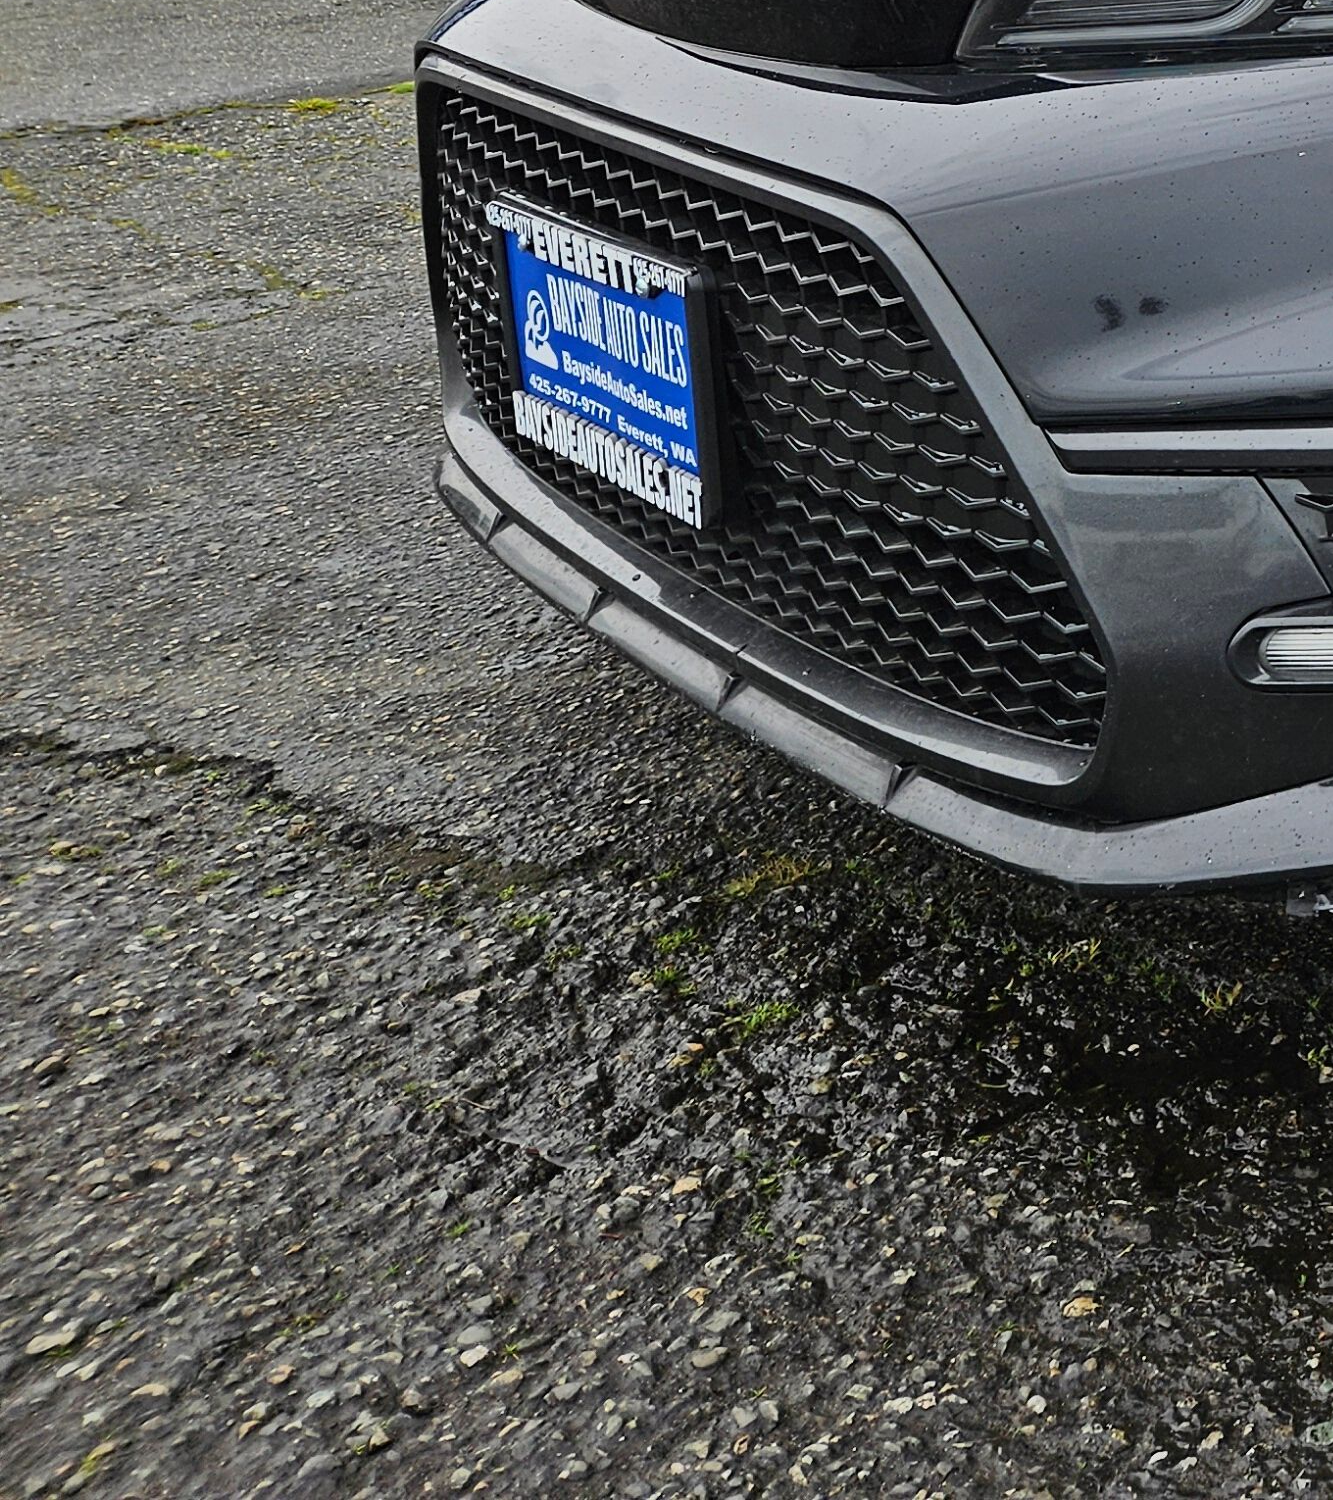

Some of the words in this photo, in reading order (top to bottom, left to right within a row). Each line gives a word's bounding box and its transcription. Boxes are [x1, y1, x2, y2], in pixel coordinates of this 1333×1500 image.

[532, 218, 635, 295] EVERETT
[546, 273, 606, 351] BAYSIDE
[602, 296, 639, 369] AUTO
[640, 310, 687, 388] SALES
[529, 372, 612, 423] 425-267-9777
[617, 414, 668, 458] Everett,
[670, 440, 698, 468] WA
[561, 350, 688, 430] BaysideAutoSales.net
[512, 389, 702, 531] BAYSIDEAUTOSALES.NET
